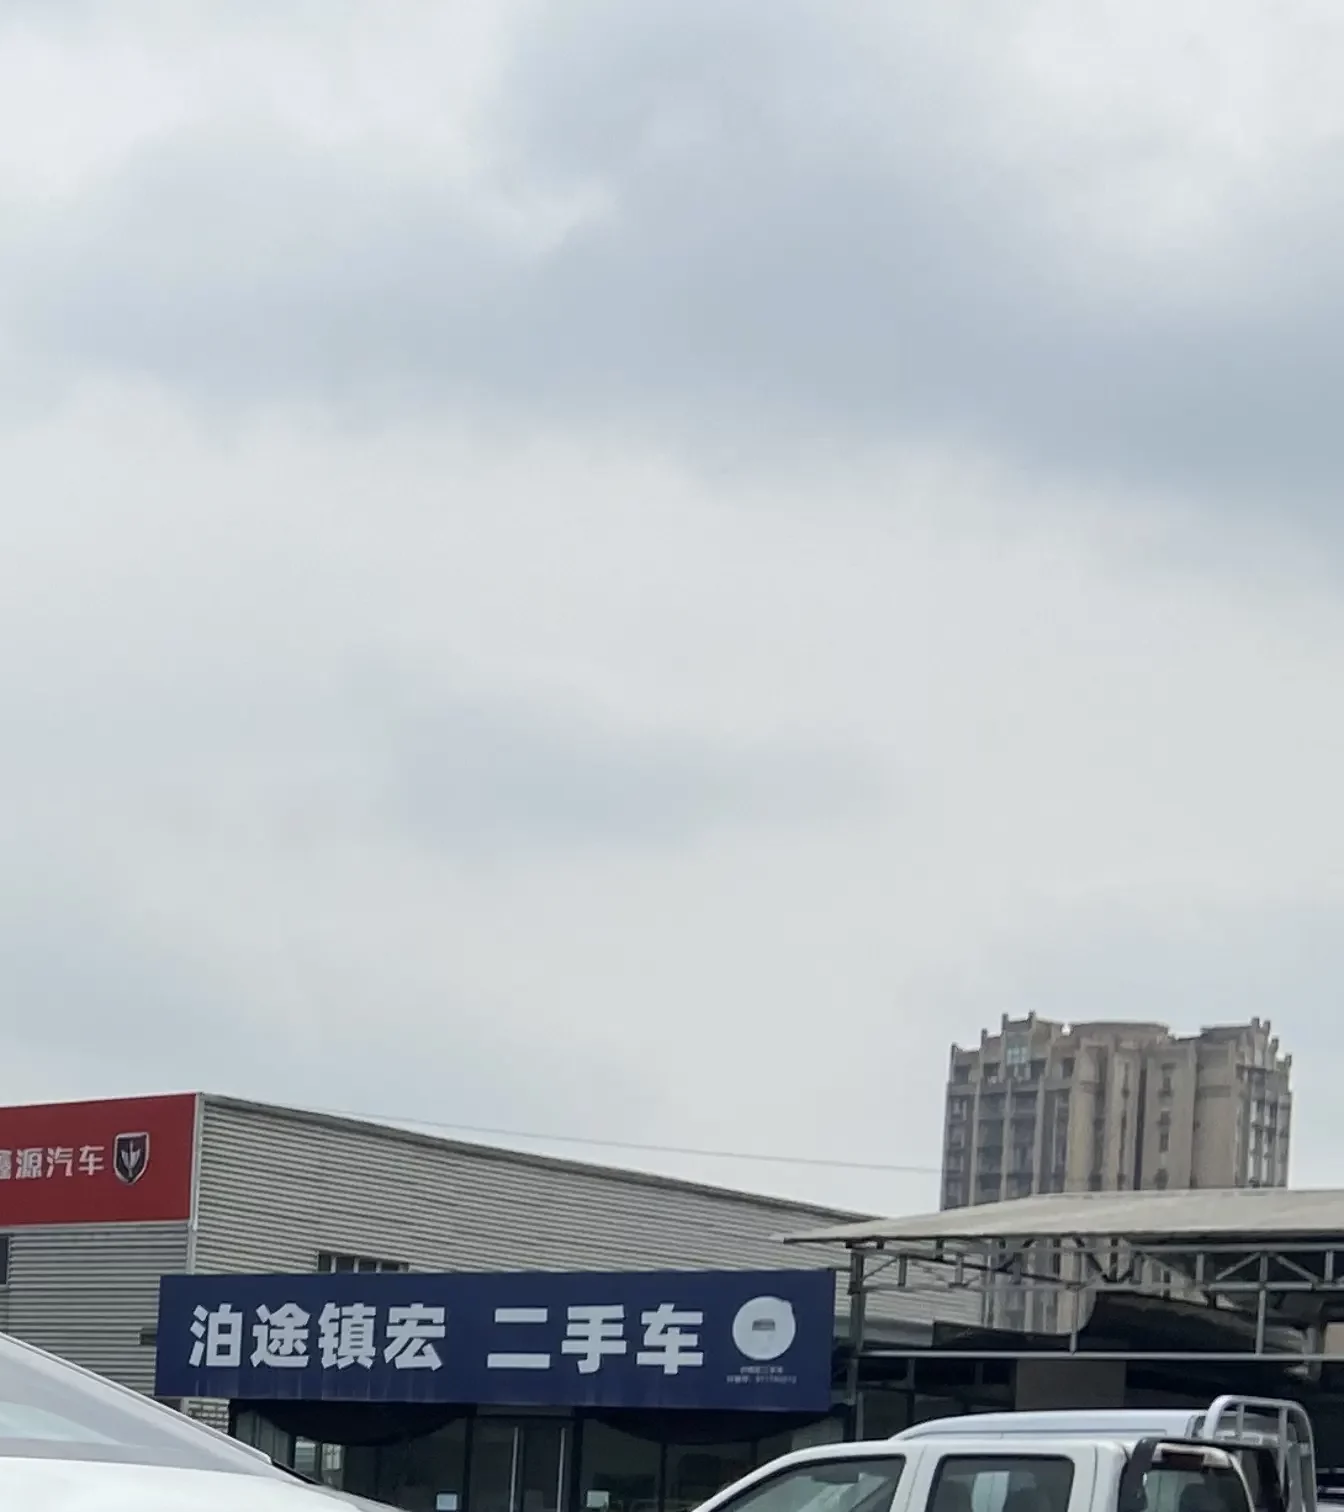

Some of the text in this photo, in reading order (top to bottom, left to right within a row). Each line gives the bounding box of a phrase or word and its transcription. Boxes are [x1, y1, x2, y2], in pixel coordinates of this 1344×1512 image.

[188, 1303, 704, 1375] 泊途镇宏 二手车
